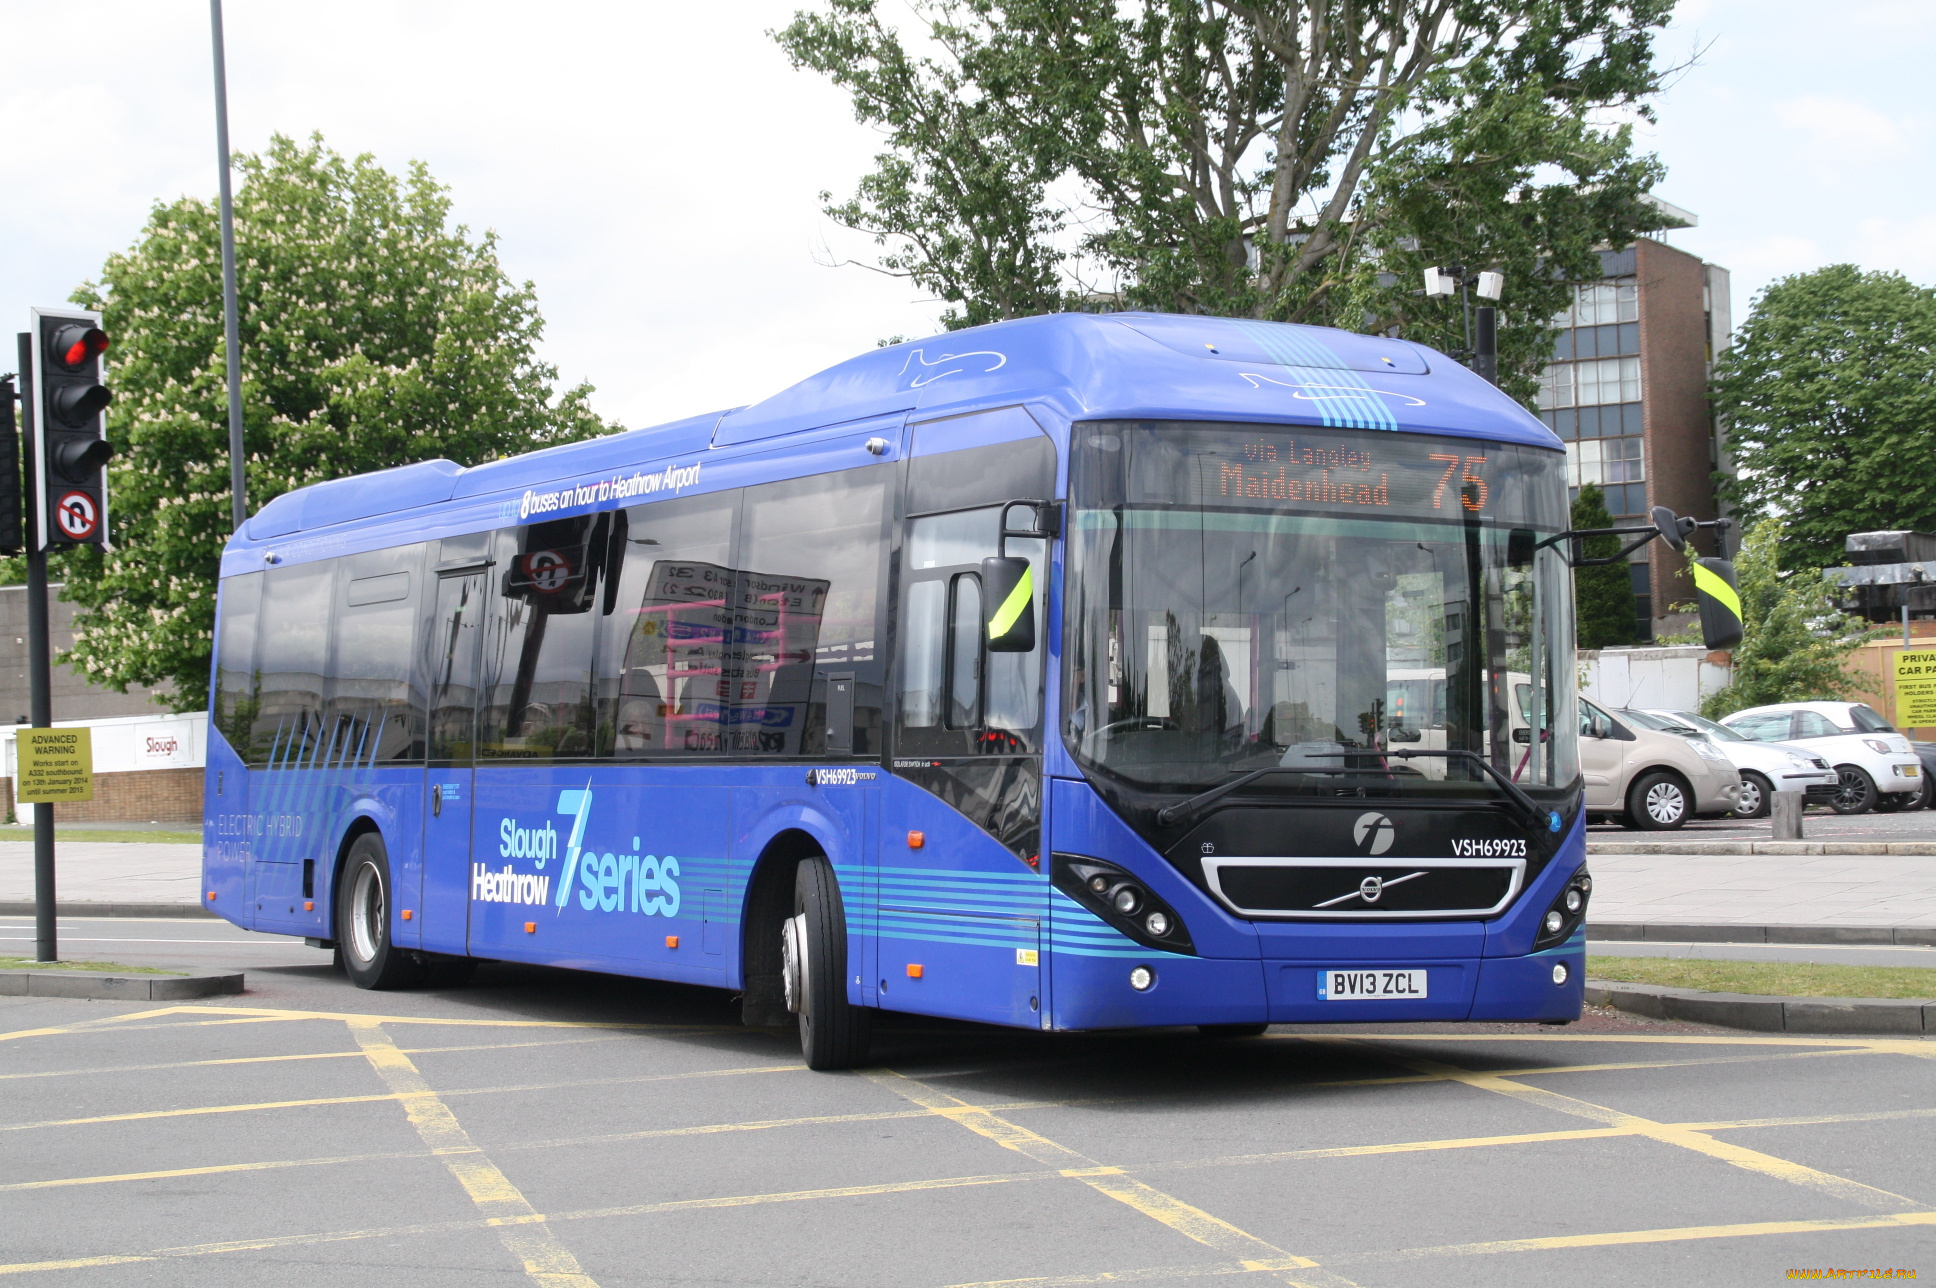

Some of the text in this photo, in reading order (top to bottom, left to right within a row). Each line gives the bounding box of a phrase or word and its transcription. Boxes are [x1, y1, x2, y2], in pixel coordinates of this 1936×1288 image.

[1245, 439, 1370, 472] via Langley
[521, 490, 531, 519] 8
[530, 491, 559, 514] buses
[559, 491, 574, 508] an
[574, 483, 600, 506] hour
[599, 480, 609, 501] to
[609, 472, 662, 499] Heathrow
[662, 461, 700, 494] Airport
[1221, 462, 1389, 506] Maidenhead
[1429, 453, 1487, 511] 75
[1902, 654, 1936, 663] PRIVA
[1898, 666, 1922, 675] CAR
[31, 734, 78, 744] ADVANCED
[146, 736, 178, 756] Slough
[35, 745, 76, 755] WARNING
[46, 768, 83, 776] southbound
[47, 778, 72, 786] January
[815, 769, 876, 785] VSH69923 VOLVO
[218, 814, 264, 836] ELECTRIC
[266, 815, 302, 837] HYBRID
[218, 841, 252, 862] POWER
[500, 817, 557, 870] Slough
[555, 782, 680, 918] 7 series
[1451, 839, 1527, 857] VSH69923
[472, 863, 549, 905] Heathrow
[1334, 973, 1377, 995] BV13
[1382, 973, 1419, 994] ZCL
